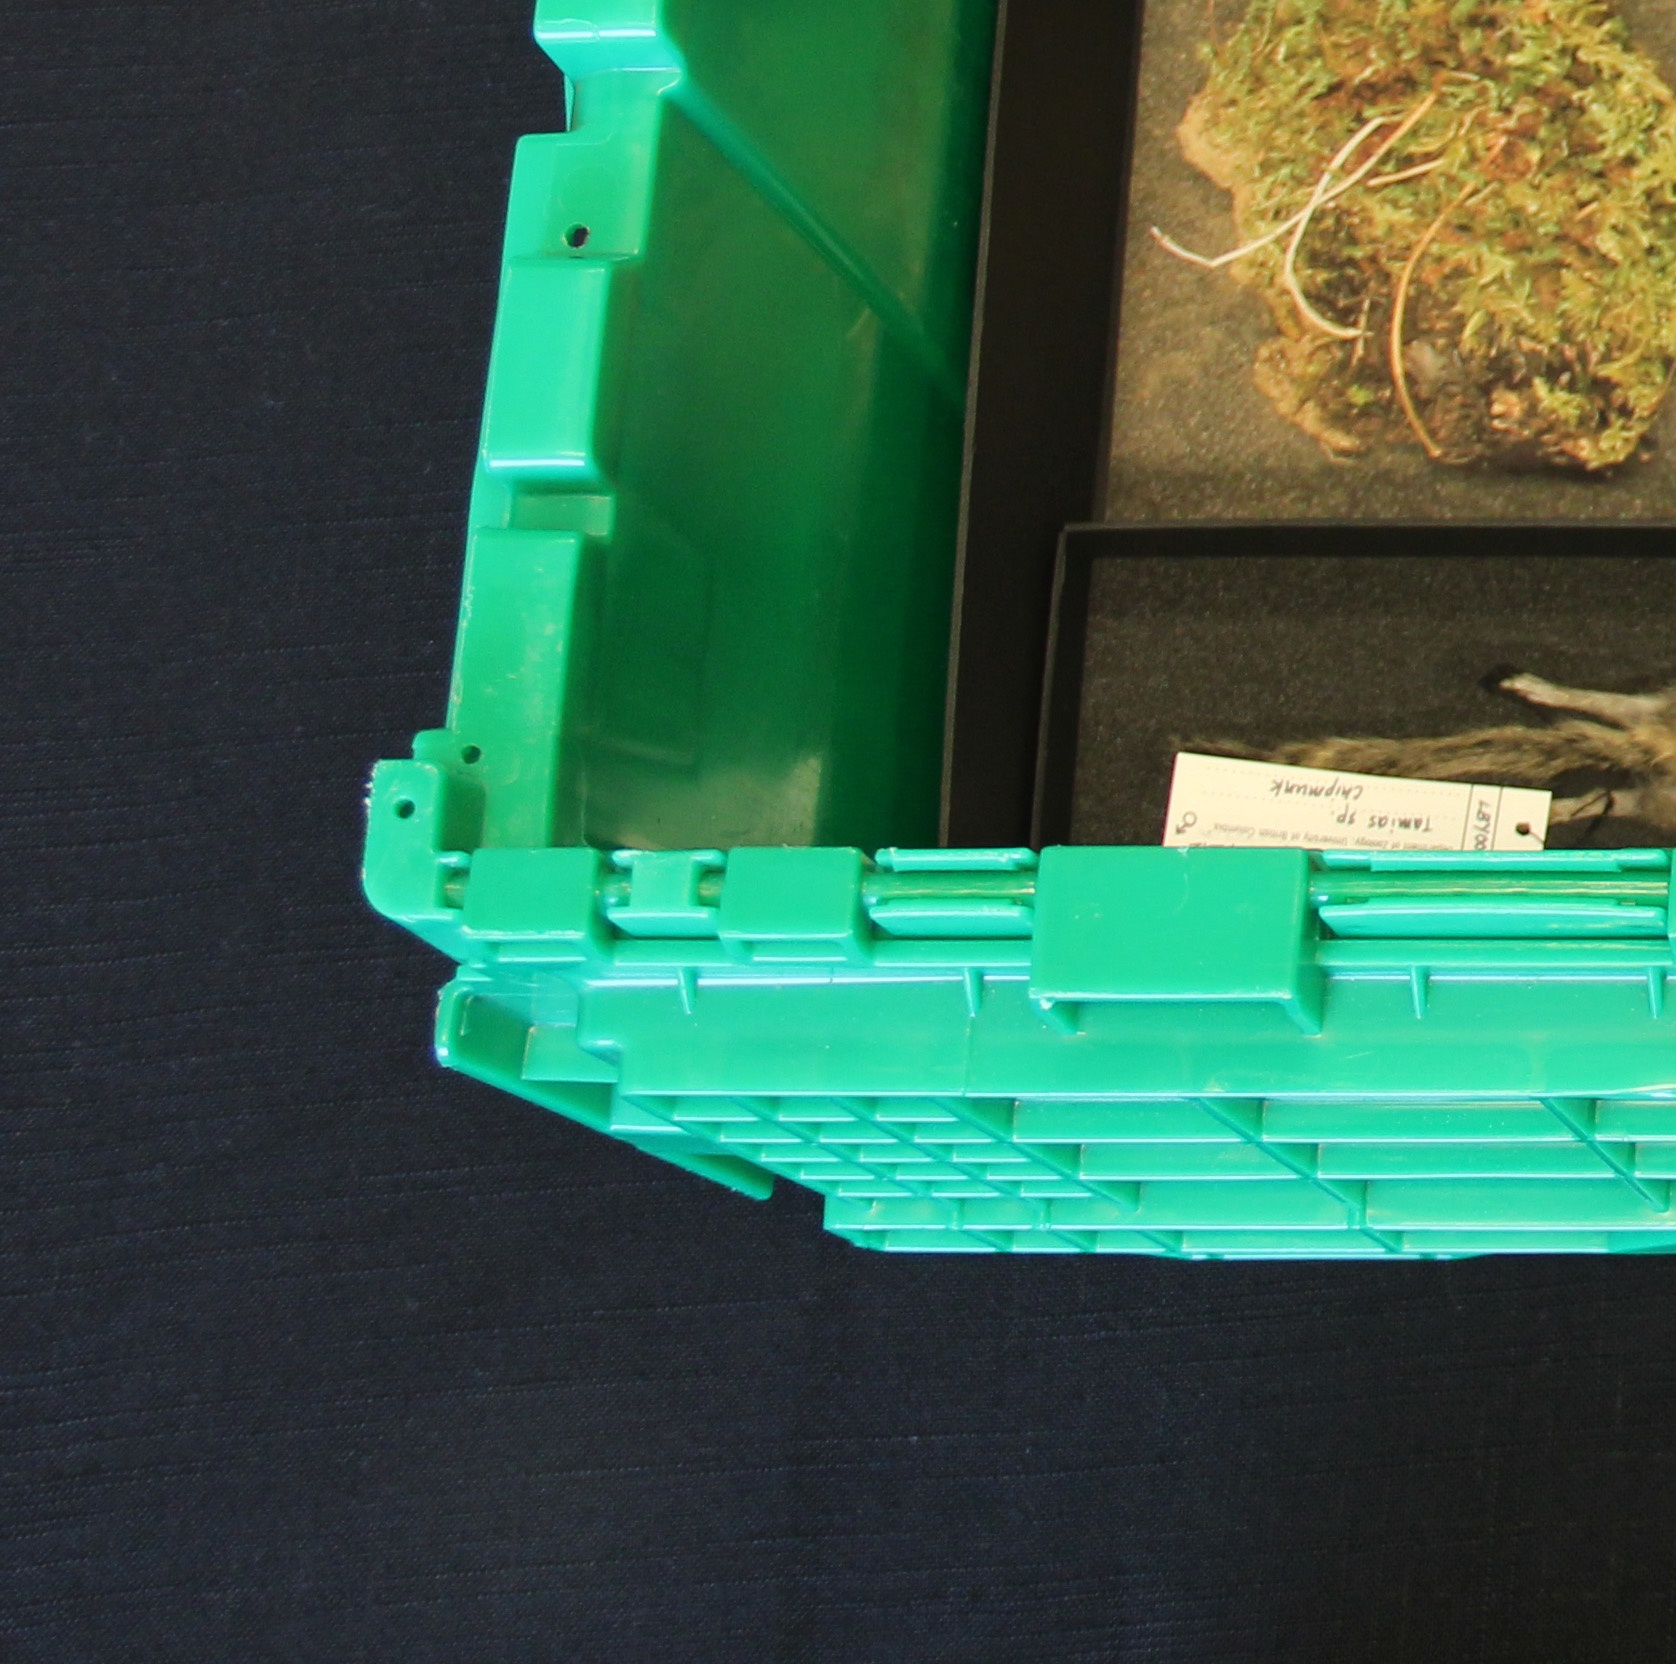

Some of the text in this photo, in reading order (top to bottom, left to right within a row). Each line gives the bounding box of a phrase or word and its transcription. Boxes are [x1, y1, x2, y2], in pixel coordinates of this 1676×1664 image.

[1269, 776, 1364, 801] Chipmunk
[1213, 822, 1256, 840] Columbia
[1258, 826, 1289, 841] British
[1368, 815, 1433, 835] Tamias
[1303, 832, 1349, 847] University
